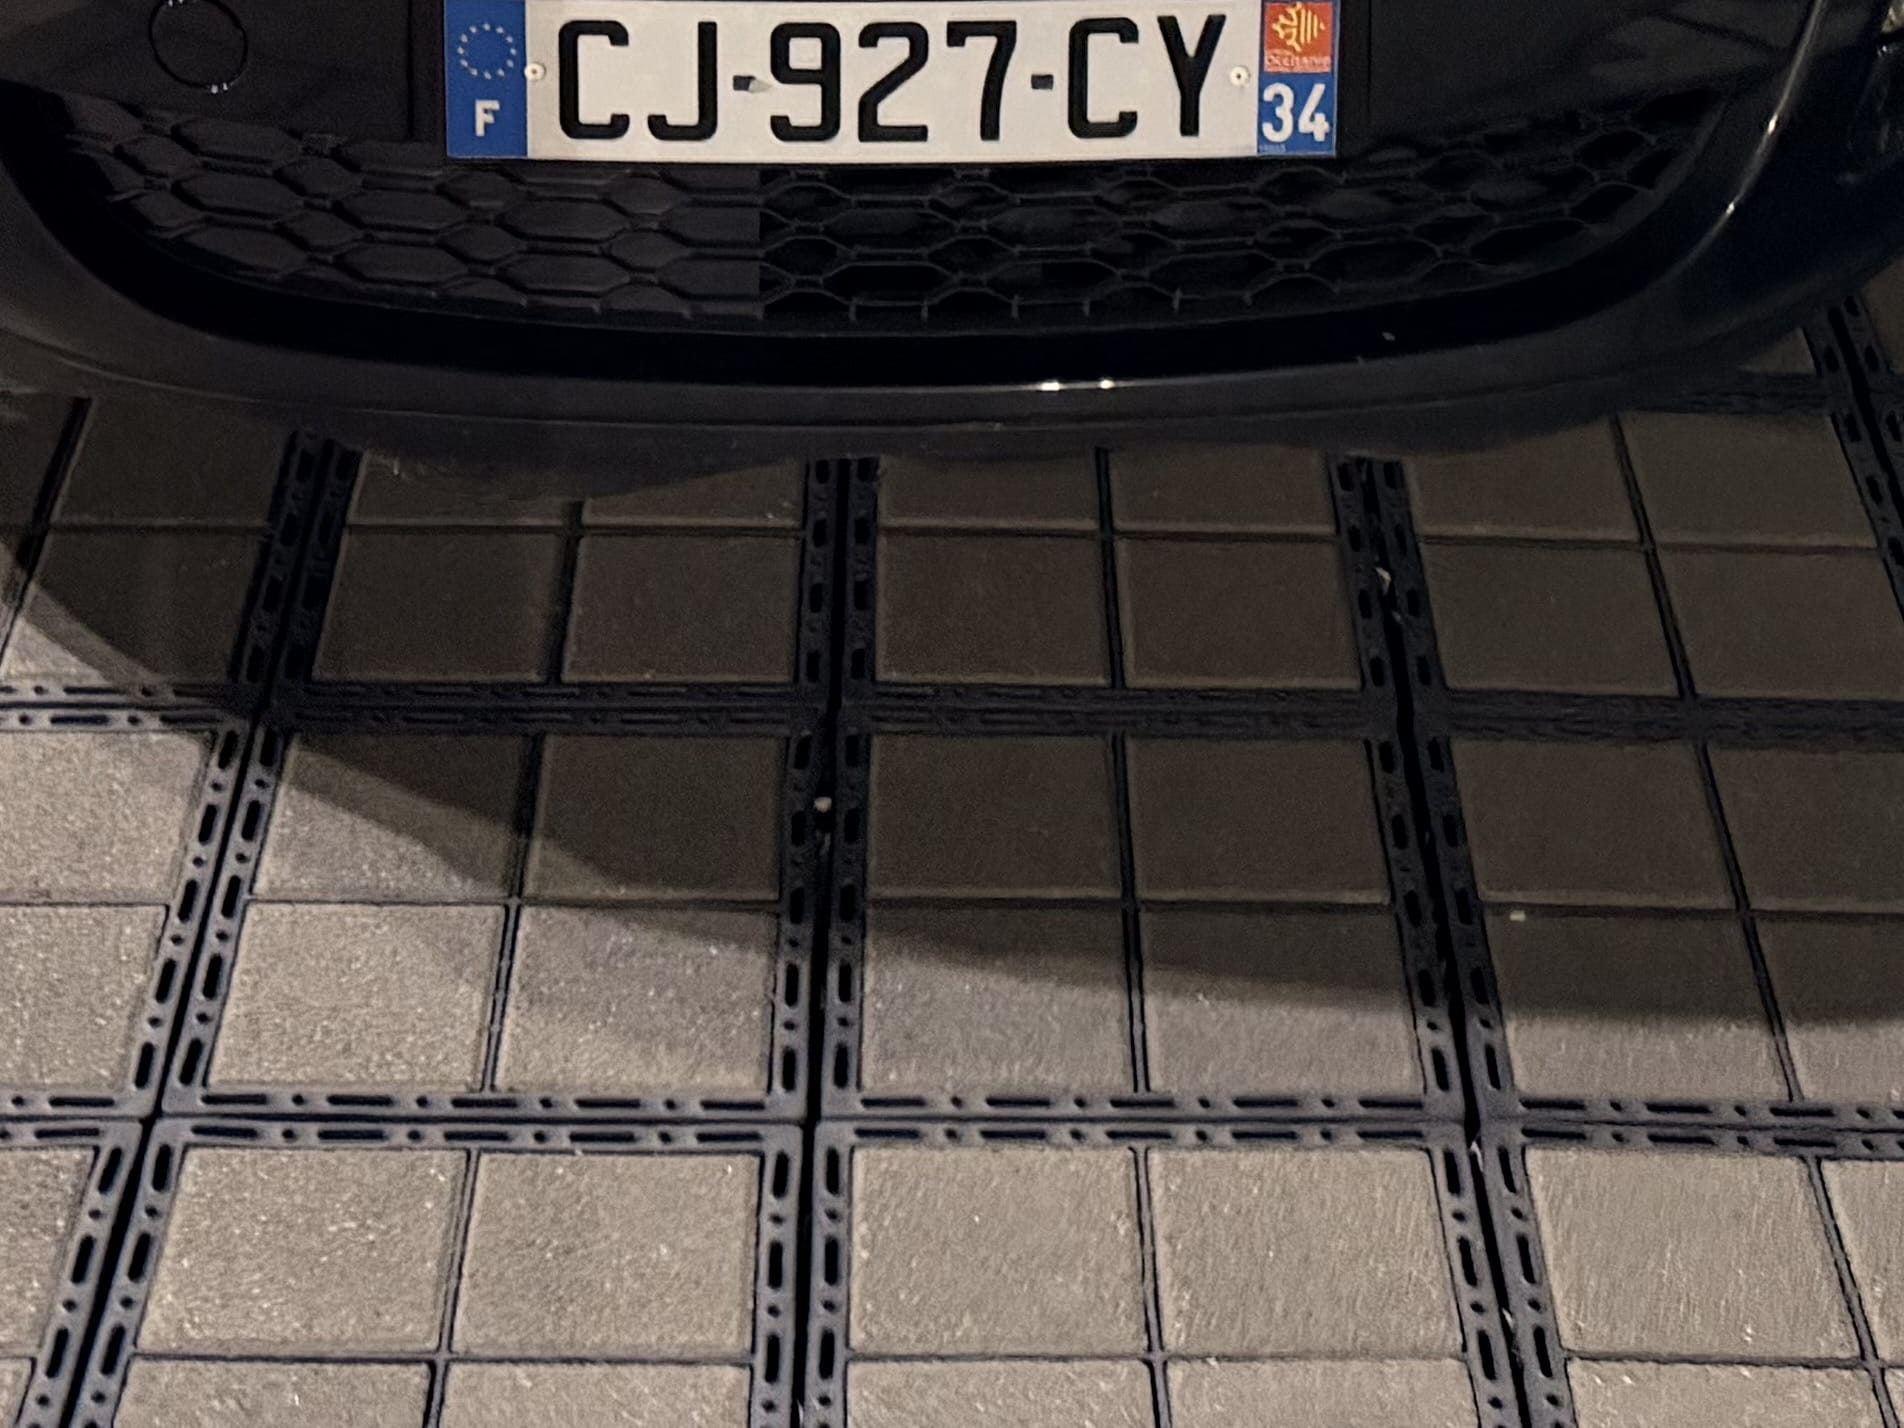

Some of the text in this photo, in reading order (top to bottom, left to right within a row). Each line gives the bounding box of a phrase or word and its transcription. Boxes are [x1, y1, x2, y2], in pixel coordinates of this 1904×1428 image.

[557, 16, 1227, 142] CJ-927-CY
[475, 99, 500, 137] F
[1262, 83, 1330, 142] 34
